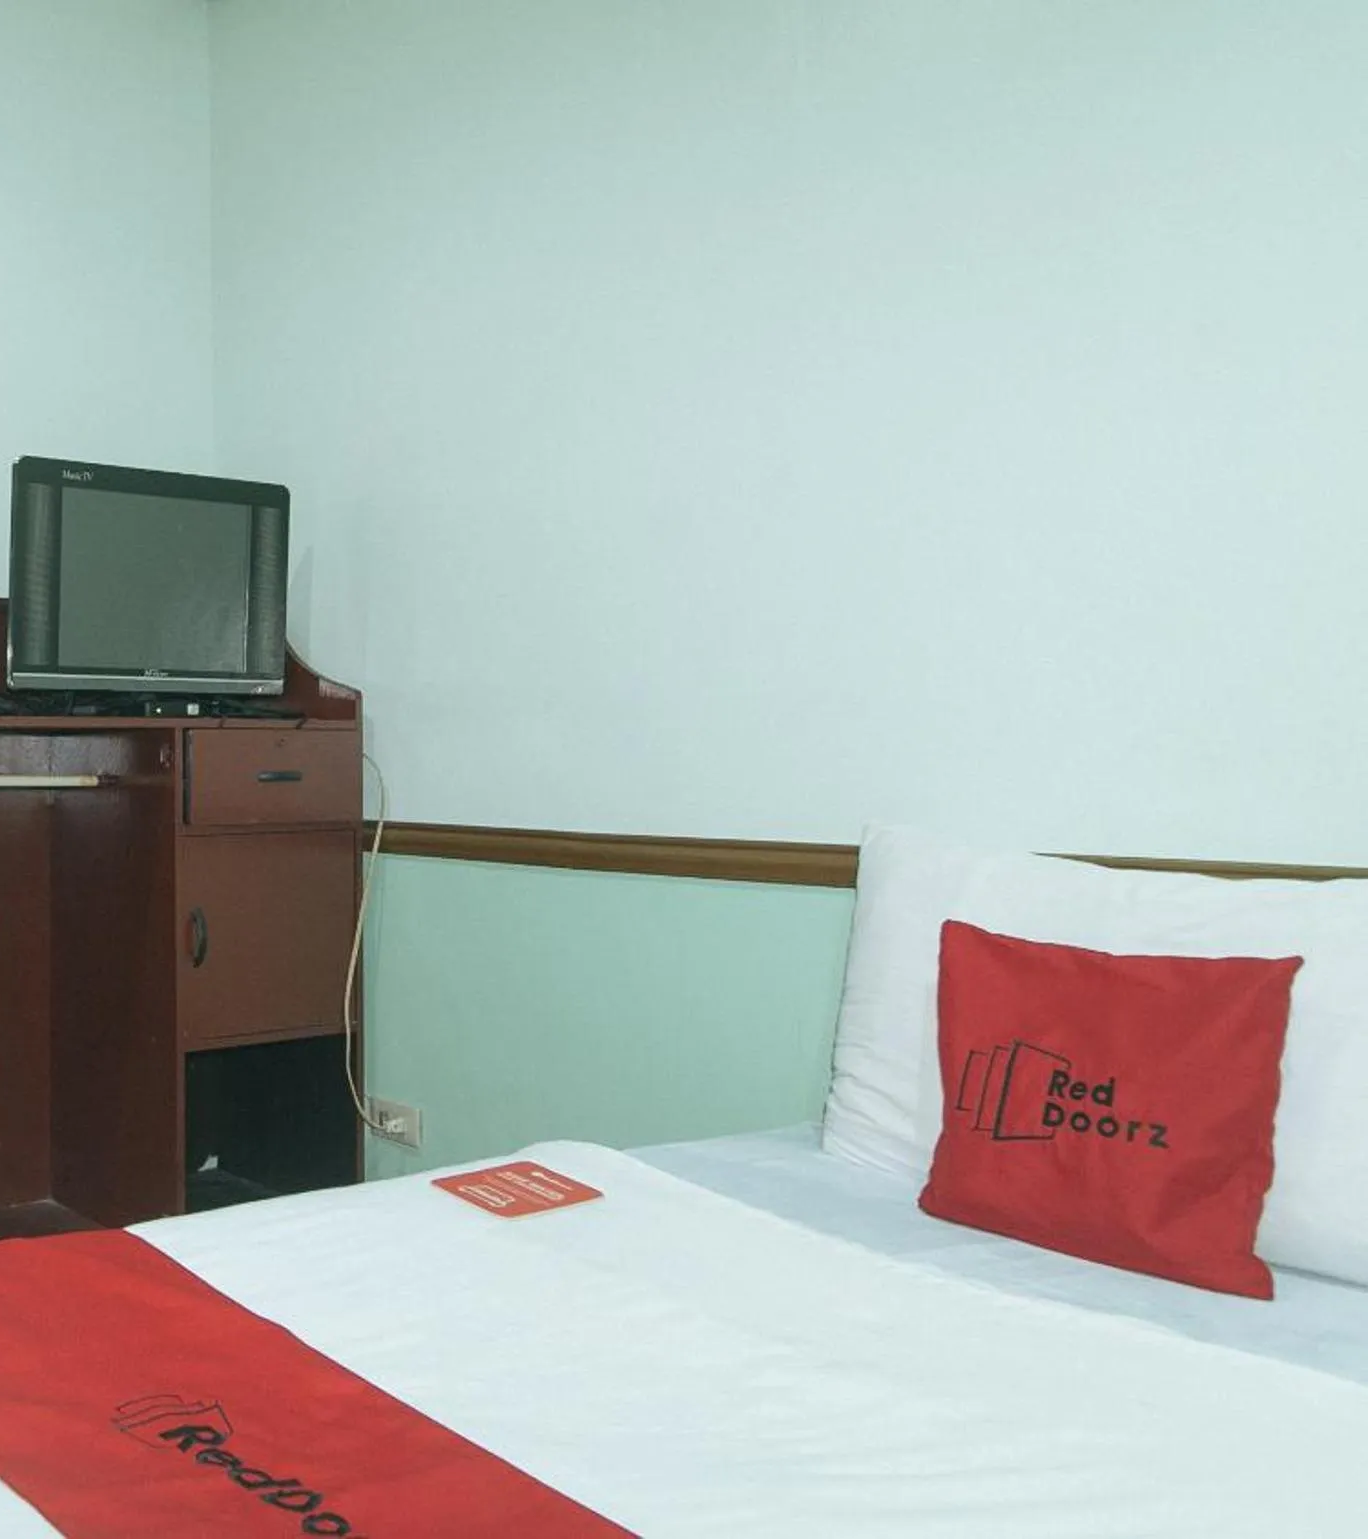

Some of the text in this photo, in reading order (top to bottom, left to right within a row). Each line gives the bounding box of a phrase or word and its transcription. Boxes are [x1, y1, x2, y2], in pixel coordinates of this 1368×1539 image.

[1047, 1069, 1115, 1107] Red
[1042, 1102, 1170, 1149] Doorz
[159, 1425, 369, 1539] RedDo
